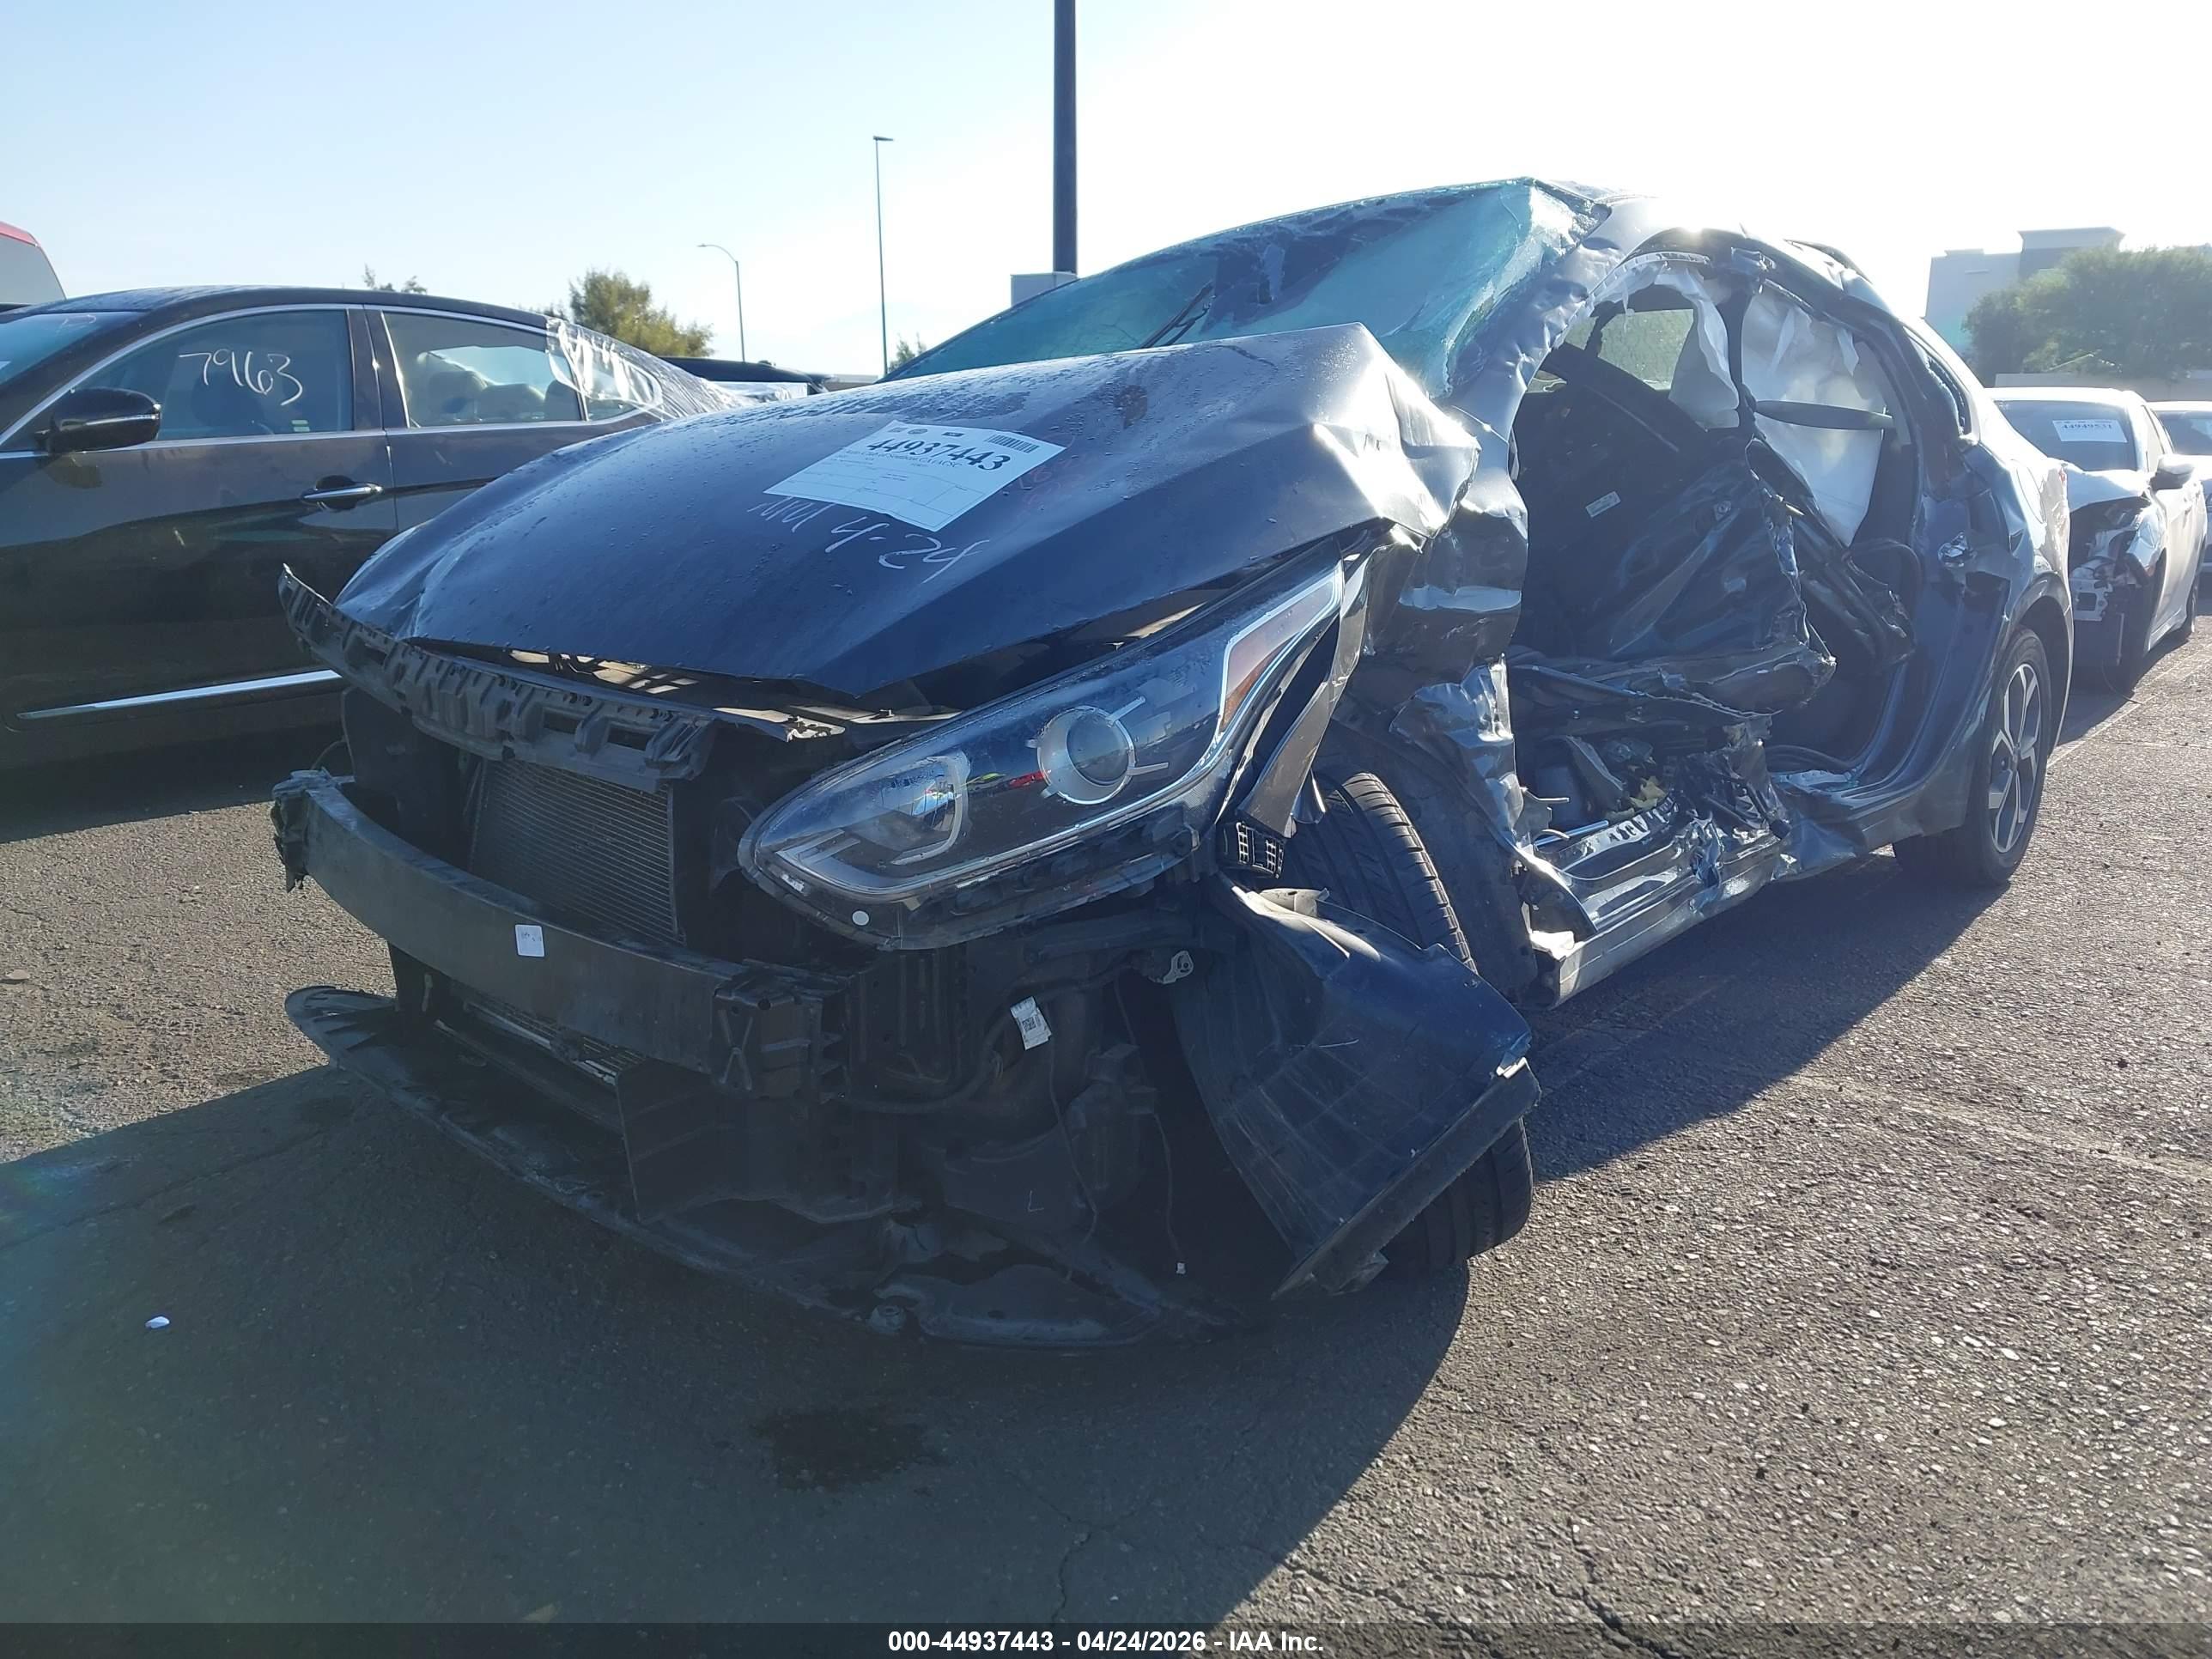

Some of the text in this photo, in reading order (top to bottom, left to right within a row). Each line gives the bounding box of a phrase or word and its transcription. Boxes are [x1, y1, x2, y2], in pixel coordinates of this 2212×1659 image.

[179, 348, 304, 407] 7963
[866, 439, 1011, 471] 44937443
[825, 516, 990, 584] 4-24
